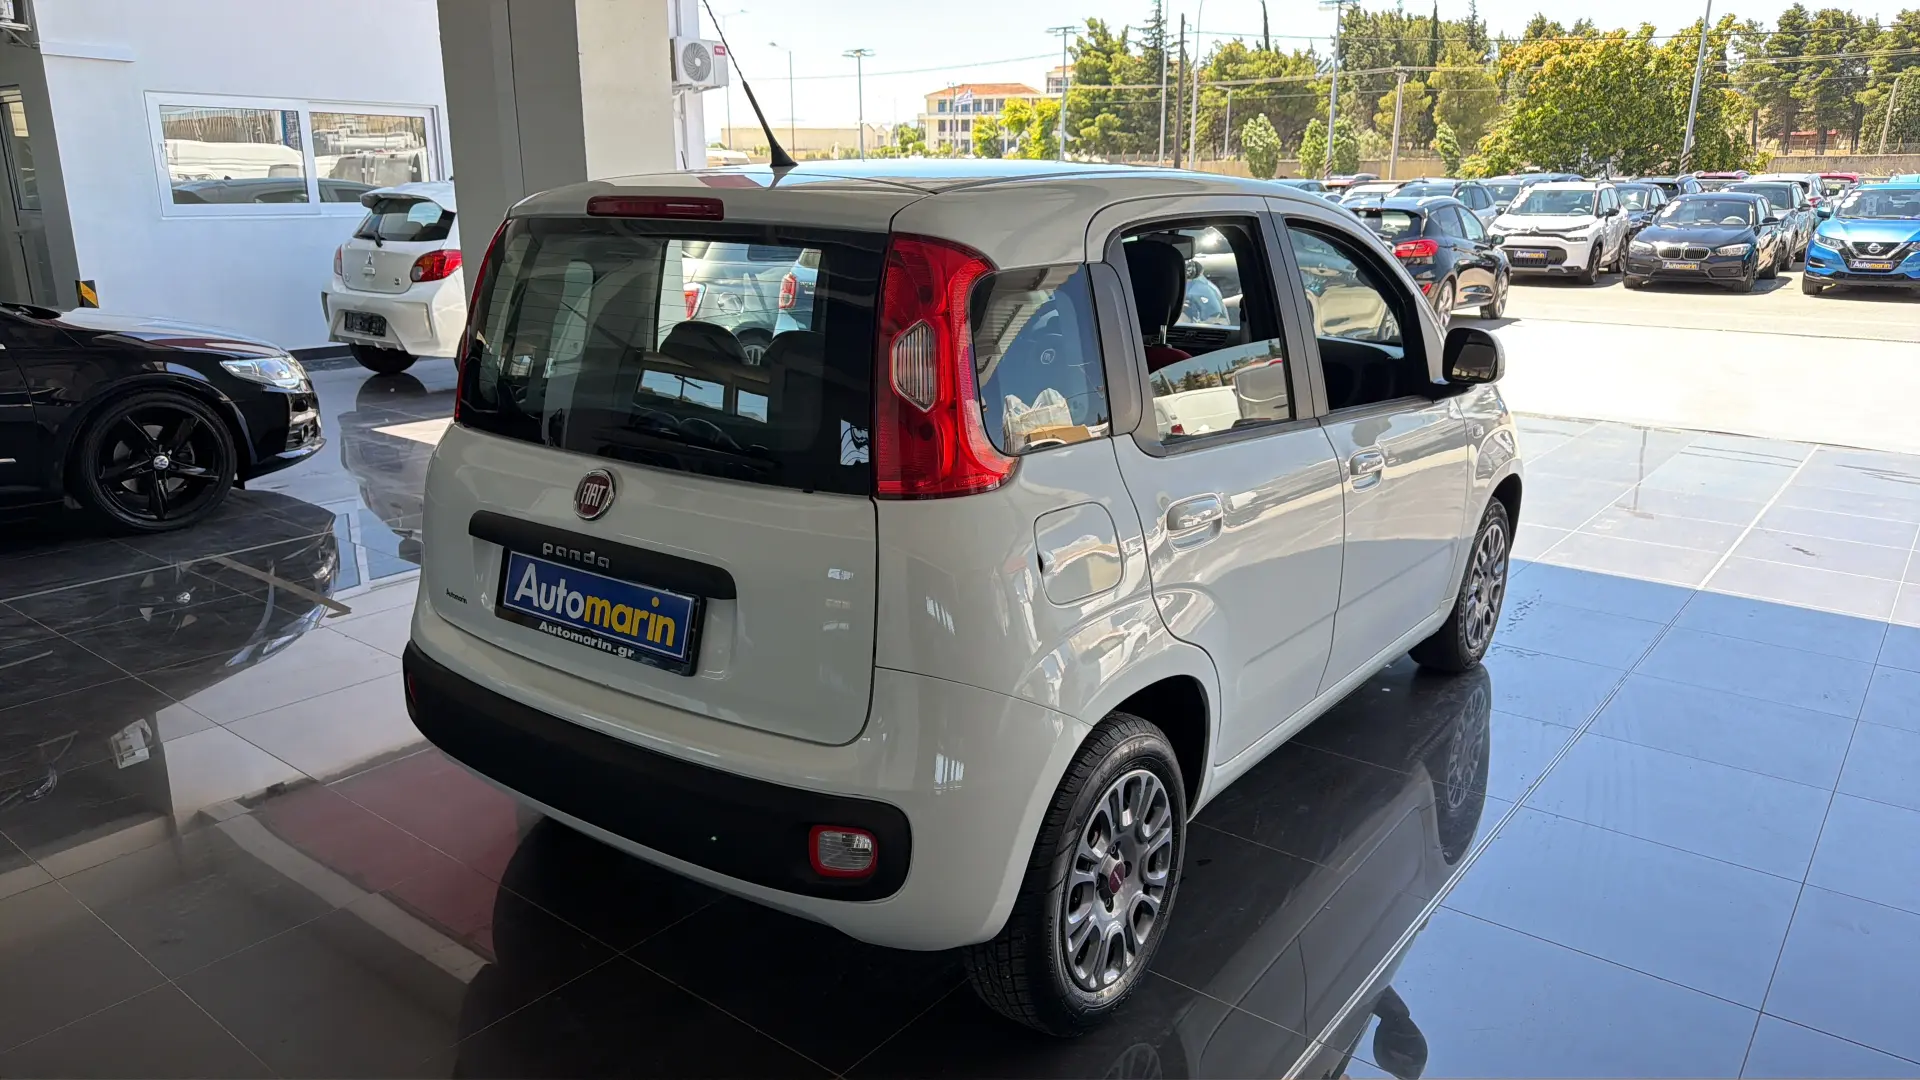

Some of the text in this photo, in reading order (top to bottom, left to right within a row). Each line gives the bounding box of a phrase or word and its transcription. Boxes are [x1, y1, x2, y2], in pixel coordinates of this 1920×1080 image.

[580, 482, 607, 507] FIAT
[542, 542, 610, 569] panda
[513, 562, 676, 647] Automarin
[538, 621, 635, 659] Automarin.gr
